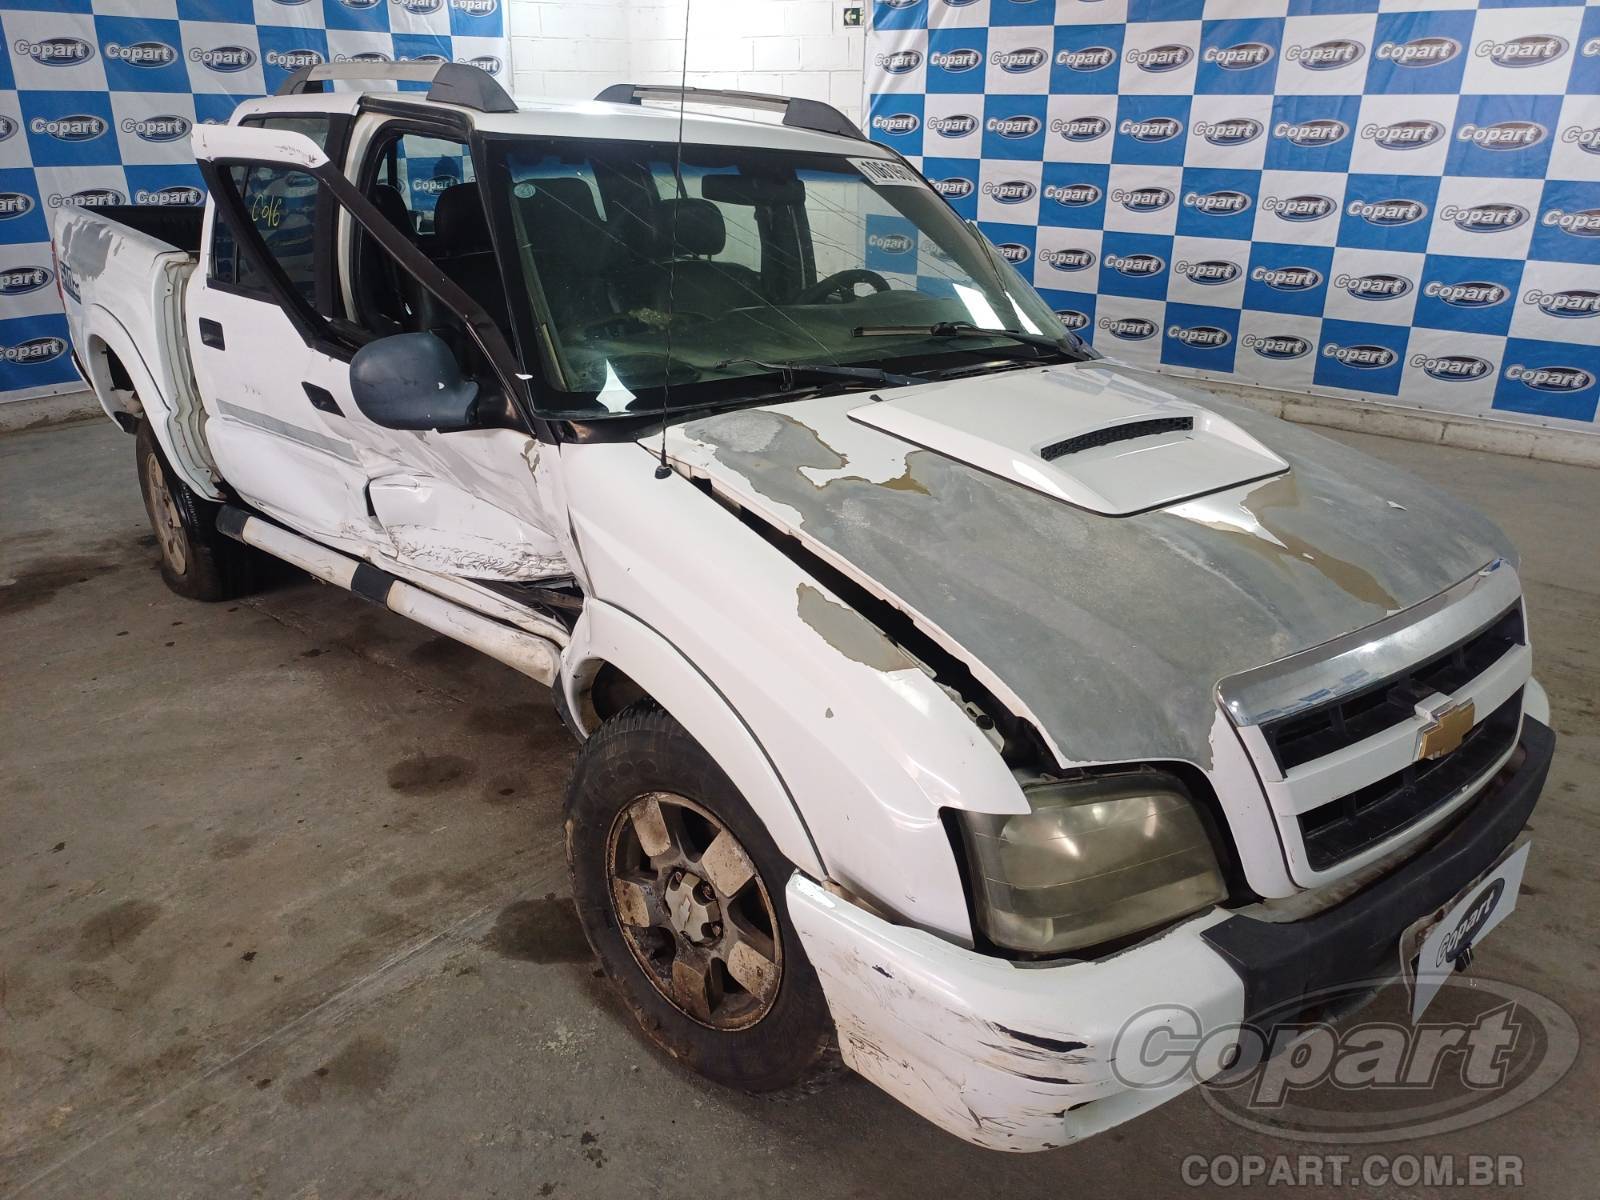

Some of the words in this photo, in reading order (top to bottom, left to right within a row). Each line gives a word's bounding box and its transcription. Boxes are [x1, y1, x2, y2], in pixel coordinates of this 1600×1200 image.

[14, 39, 86, 60] Copart
[105, 42, 171, 62] Copart
[189, 47, 248, 66] Copart
[266, 49, 320, 66] Copart
[1055, 50, 1110, 65] Copart
[1126, 49, 1186, 66] Copart
[1204, 46, 1266, 66] Copart
[1286, 44, 1355, 65] Copart
[1375, 42, 1451, 62] Copart
[1474, 40, 1560, 61] Copart
[875, 53, 918, 67] Copart
[930, 52, 978, 67] Copart
[990, 52, 1040, 67] Copart
[31, 118, 100, 135] Copart
[121, 118, 183, 135] Copart
[872, 116, 914, 130] Copart
[926, 117, 971, 132] Copart
[987, 119, 1036, 134] Copart
[1051, 119, 1105, 136] Copart
[1120, 120, 1175, 138] Copart
[1193, 121, 1253, 139] Copart
[1273, 123, 1340, 140] Copart
[1361, 124, 1434, 143] Copart
[1458, 124, 1538, 143] Copart
[1562, 126, 1600, 149] Cop
[135, 190, 200, 206] Copart
[983, 182, 1029, 197] Copart
[1044, 184, 1096, 201] Copart
[1111, 188, 1166, 207] Copart
[0, 194, 26, 211] art
[49, 193, 117, 206] Copart
[1183, 191, 1243, 209] Copart
[1262, 196, 1327, 215] Copart
[1347, 200, 1418, 219] Copart
[1440, 205, 1520, 224] Copart
[1543, 209, 1600, 231] Copa
[869, 234, 908, 250] Copart
[1000, 246, 1025, 259] art
[1040, 250, 1091, 265] Copart
[1104, 253, 1159, 271] Copart
[1175, 260, 1232, 279] Copart
[0, 269, 44, 290] part
[1252, 266, 1315, 286] Copart
[1334, 274, 1406, 293] Copart
[1424, 281, 1498, 302] Copart
[1058, 313, 1084, 327] art
[1099, 317, 1151, 334] Copart
[1168, 326, 1224, 345] Copart
[1242, 334, 1303, 353] Copart
[1323, 343, 1391, 363] Copart
[1410, 353, 1484, 374] Copart
[1505, 364, 1585, 387] Copart
[1436, 889, 1495, 968] Copart
